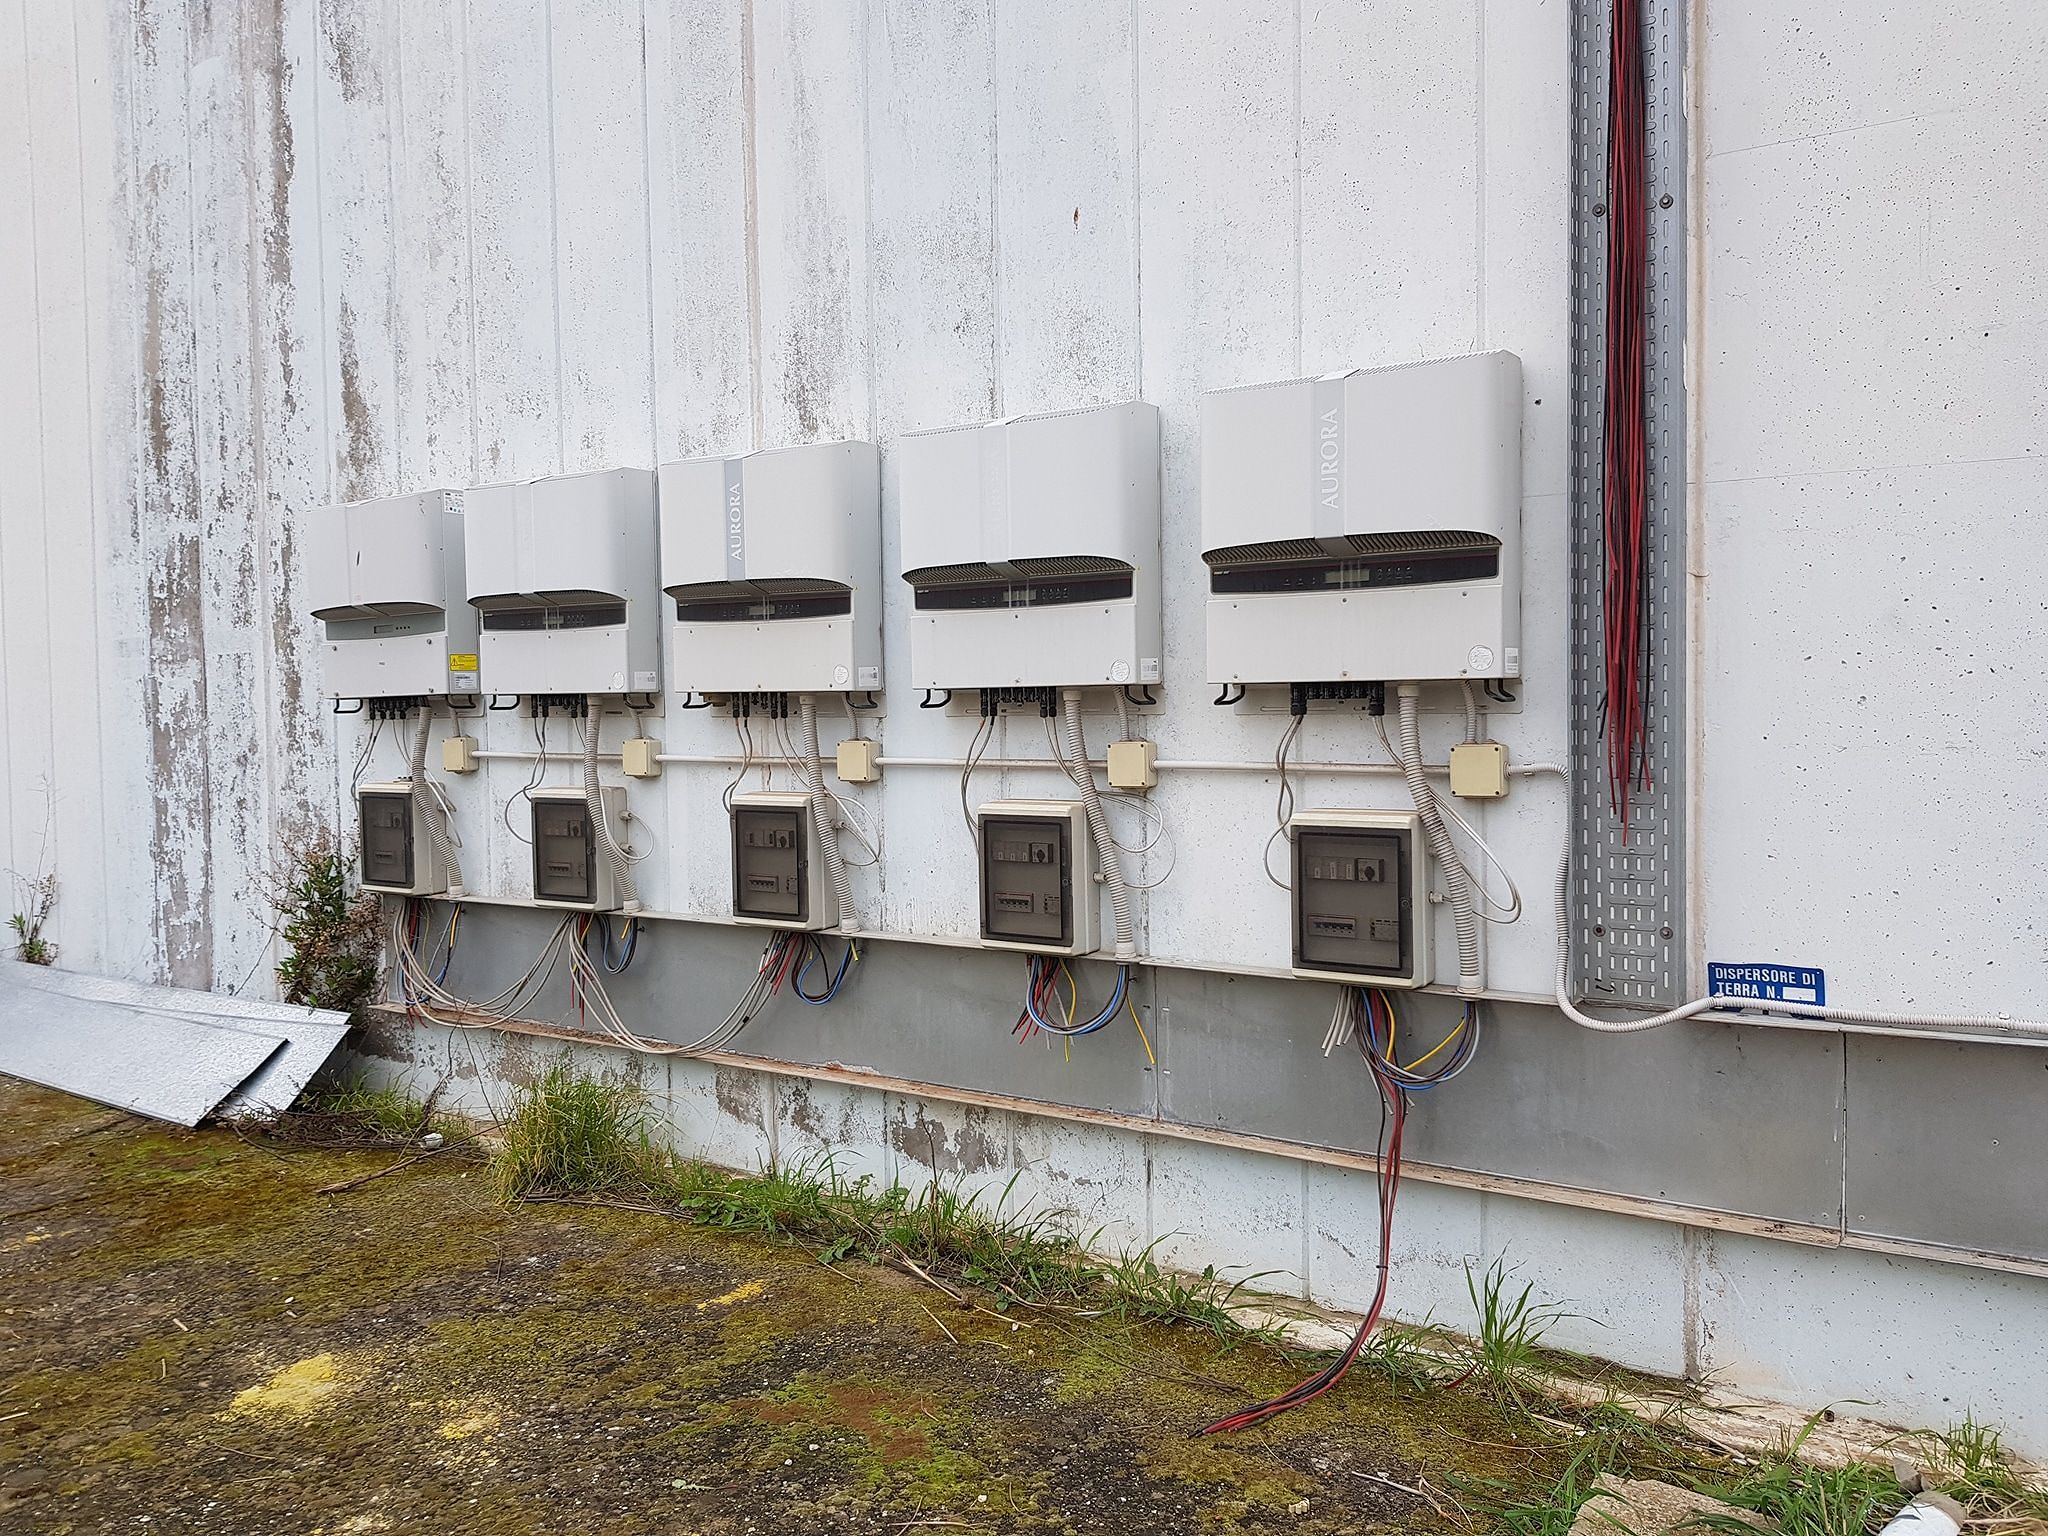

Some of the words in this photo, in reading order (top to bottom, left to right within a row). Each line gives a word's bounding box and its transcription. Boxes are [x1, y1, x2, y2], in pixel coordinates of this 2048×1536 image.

[1320, 408, 1339, 508] AURORA
[729, 483, 742, 560] AURORA
[1715, 967, 1797, 984] DISPERSORE
[1802, 973, 1816, 985] DI
[1716, 982, 1759, 997] TERRA
[1766, 985, 1781, 999] N.
